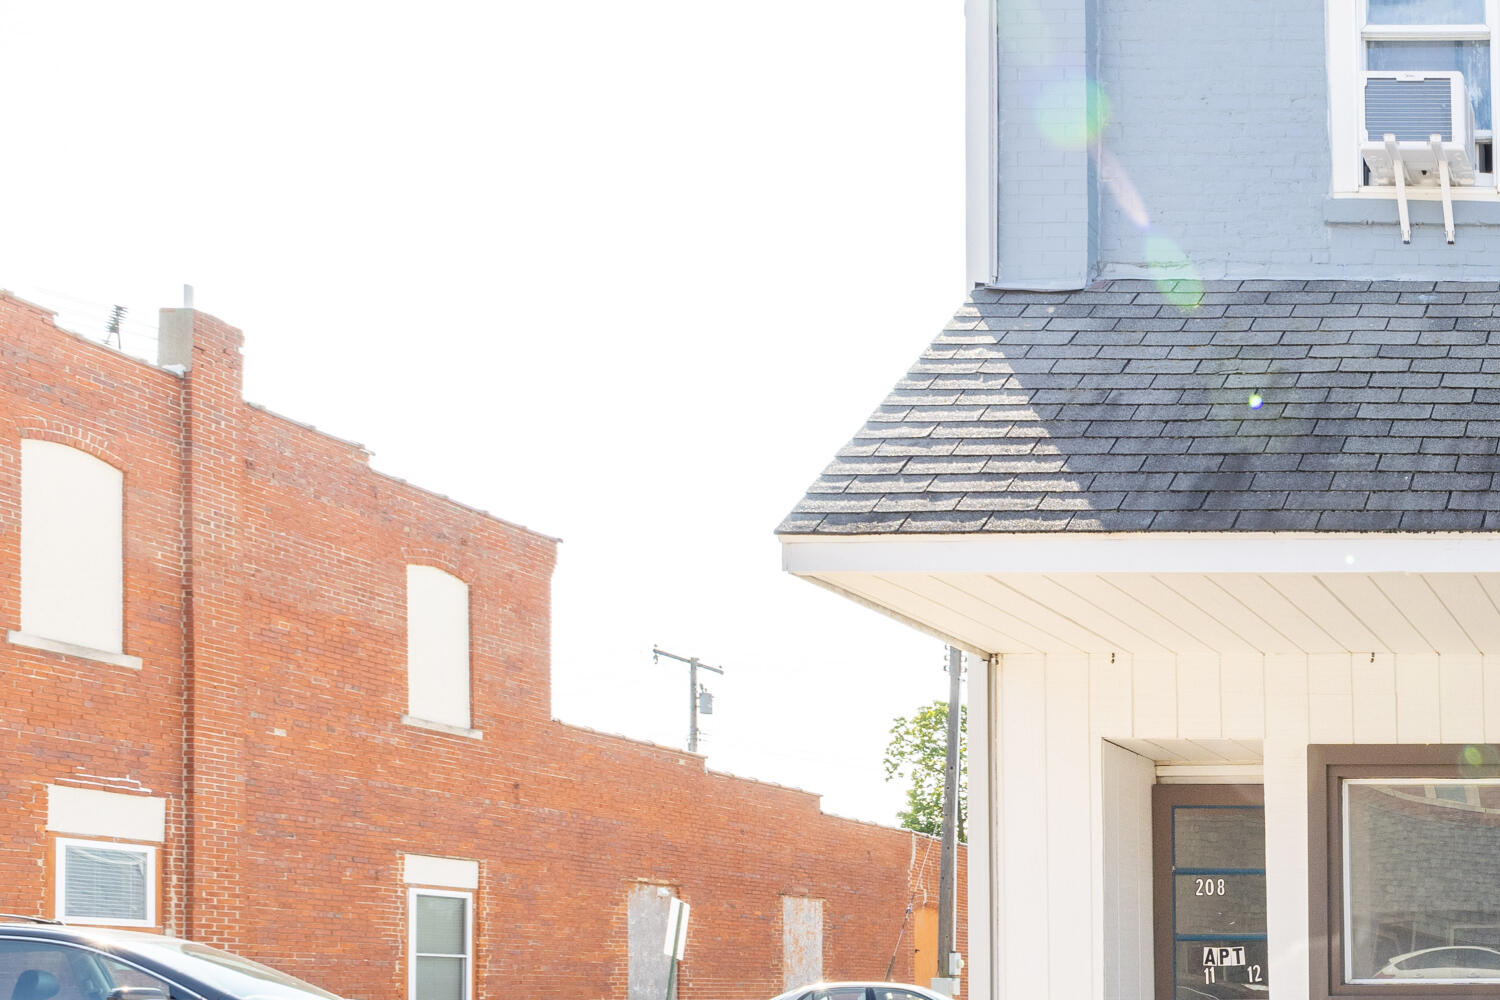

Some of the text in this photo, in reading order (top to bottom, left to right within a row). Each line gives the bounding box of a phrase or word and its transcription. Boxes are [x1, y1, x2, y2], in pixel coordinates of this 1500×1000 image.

[1195, 878, 1225, 896] 208
[1204, 948, 1243, 965] APT
[1204, 965, 1262, 985] 11 12
